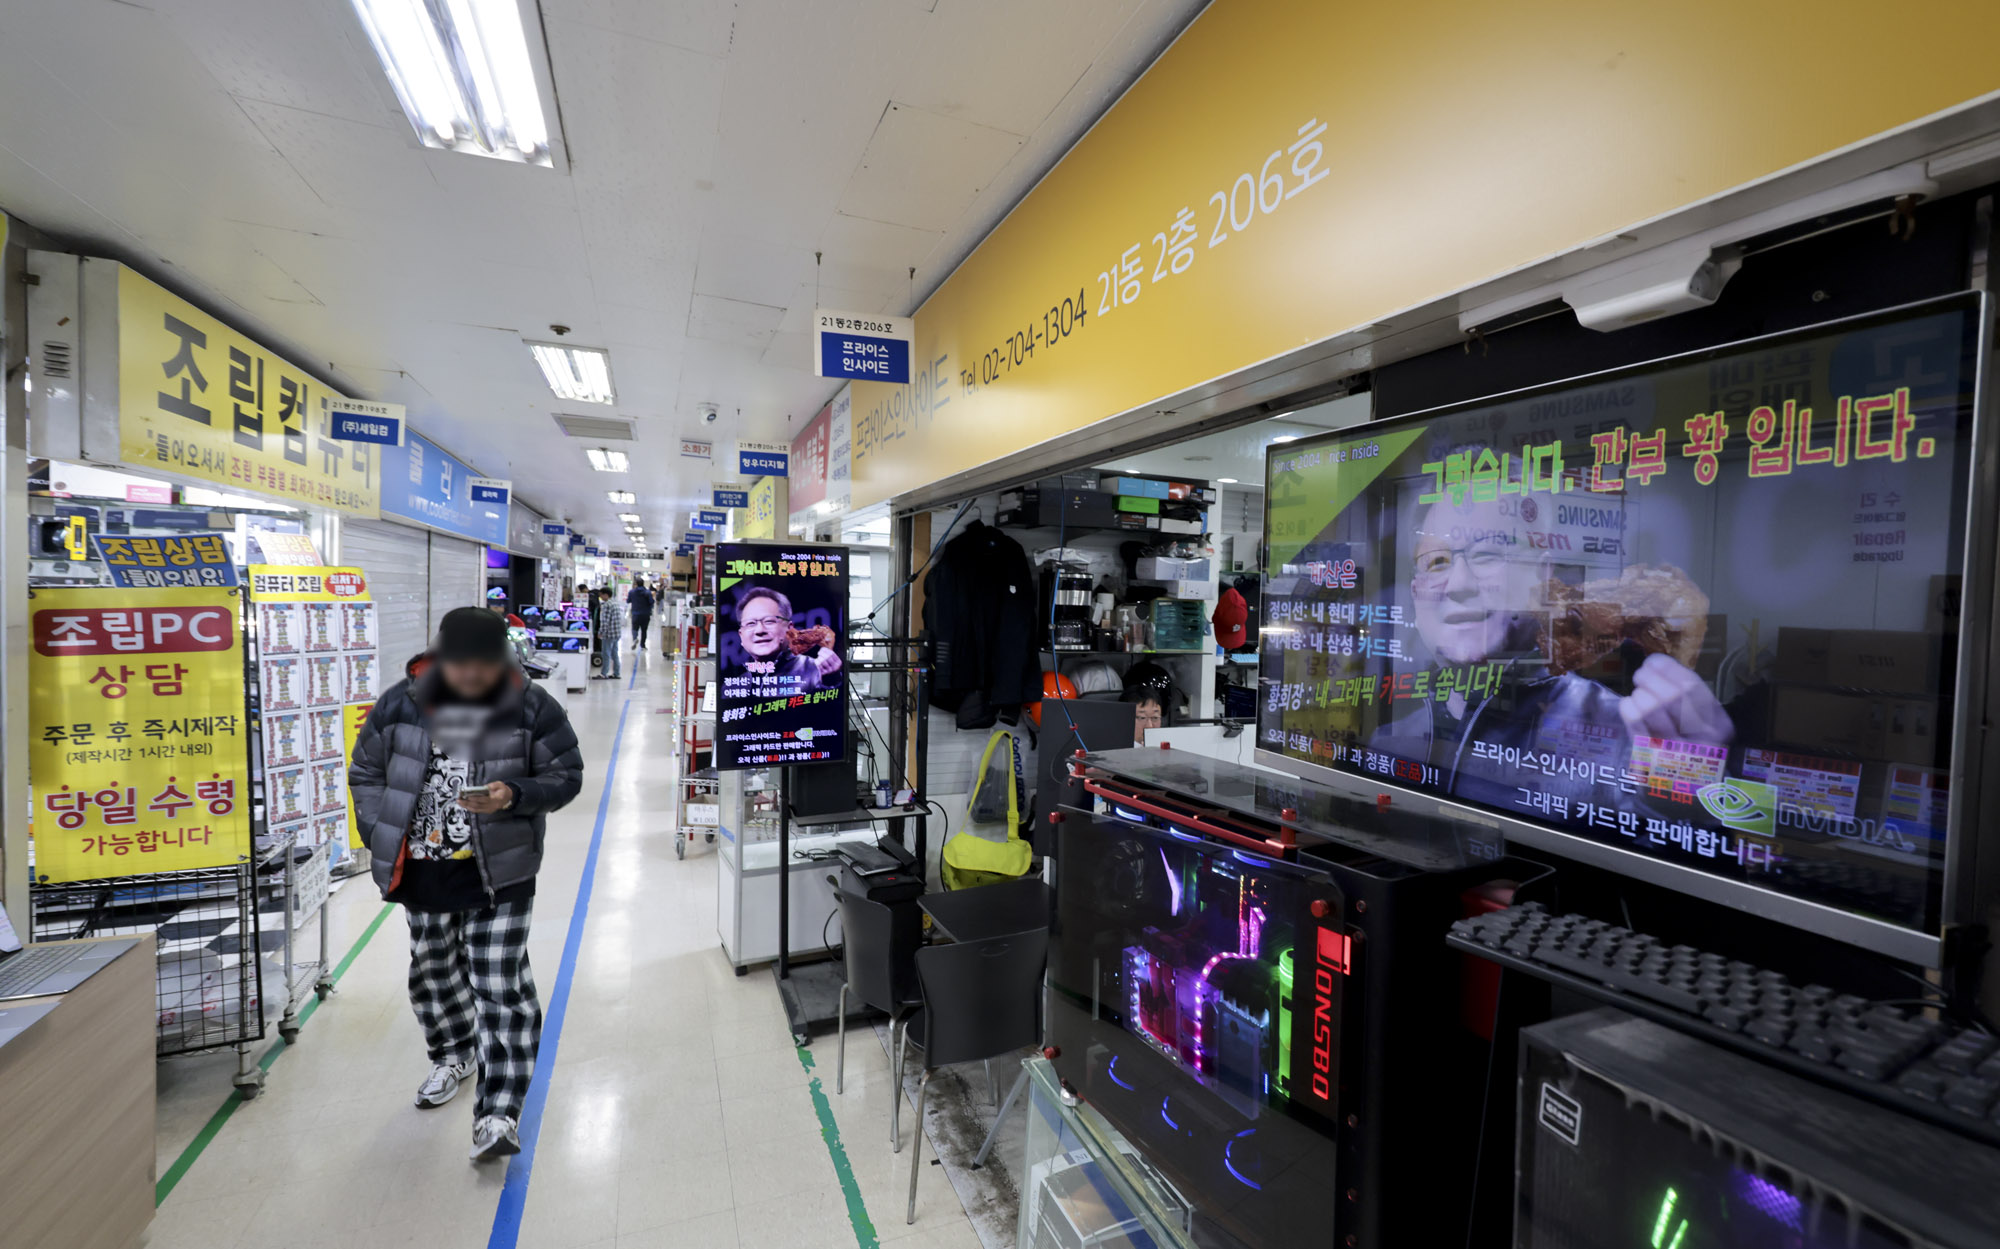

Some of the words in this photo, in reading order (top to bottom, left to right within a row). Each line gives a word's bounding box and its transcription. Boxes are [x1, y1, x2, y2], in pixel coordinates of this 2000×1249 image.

[856, 354, 951, 460] 프라이스인사이드
[960, 362, 980, 399] Tel.
[983, 287, 1088, 386] 02-704-1304
[1097, 243, 1144, 317] 21동
[1152, 207, 1198, 284] 2층
[1208, 118, 1331, 249] 206호
[842, 341, 889, 358] 프라이스
[842, 357, 889, 375] 인사이드
[342, 421, 389, 439] (주)세일컴
[1419, 440, 1575, 506] 그렇습니다.
[1590, 427, 1666, 492] 깐부
[1683, 411, 1729, 485] 황
[1746, 387, 1935, 478] 입니다.
[100, 535, 227, 567] 조립상담
[781, 552, 796, 561] Since
[797, 553, 811, 562] 2004
[254, 574, 294, 593] 컴퓨터
[297, 576, 322, 594] 조립
[1306, 560, 1357, 588] 계산은
[1268, 601, 1308, 624] 정의선:
[1311, 602, 1324, 622] 내
[1328, 602, 1355, 625] 현대
[47, 611, 222, 653] 조립PC
[1310, 633, 1323, 652] 내
[1327, 635, 1353, 657] 삼성
[89, 663, 189, 700] 상담
[1315, 680, 1328, 710] 내
[1330, 675, 1376, 706] 그래픽
[1379, 671, 1431, 705] 카드로
[788, 694, 811, 708] 카드로
[43, 723, 96, 746] 주문
[106, 721, 133, 744] 후
[142, 714, 239, 742] 즉시제작
[66, 747, 134, 767] (제작시간
[139, 744, 177, 760] 1시간
[180, 742, 213, 758] 내외)
[1350, 749, 1364, 765] 과
[1471, 740, 1640, 796] 프라이스인사이드는
[45, 780, 137, 830] 당일
[148, 773, 237, 818] 수령
[82, 824, 214, 857] 가능합니다
[1515, 786, 1569, 820] 그래픽
[1576, 803, 1639, 838] 카드만
[1646, 817, 1783, 876] 판매합니다.
